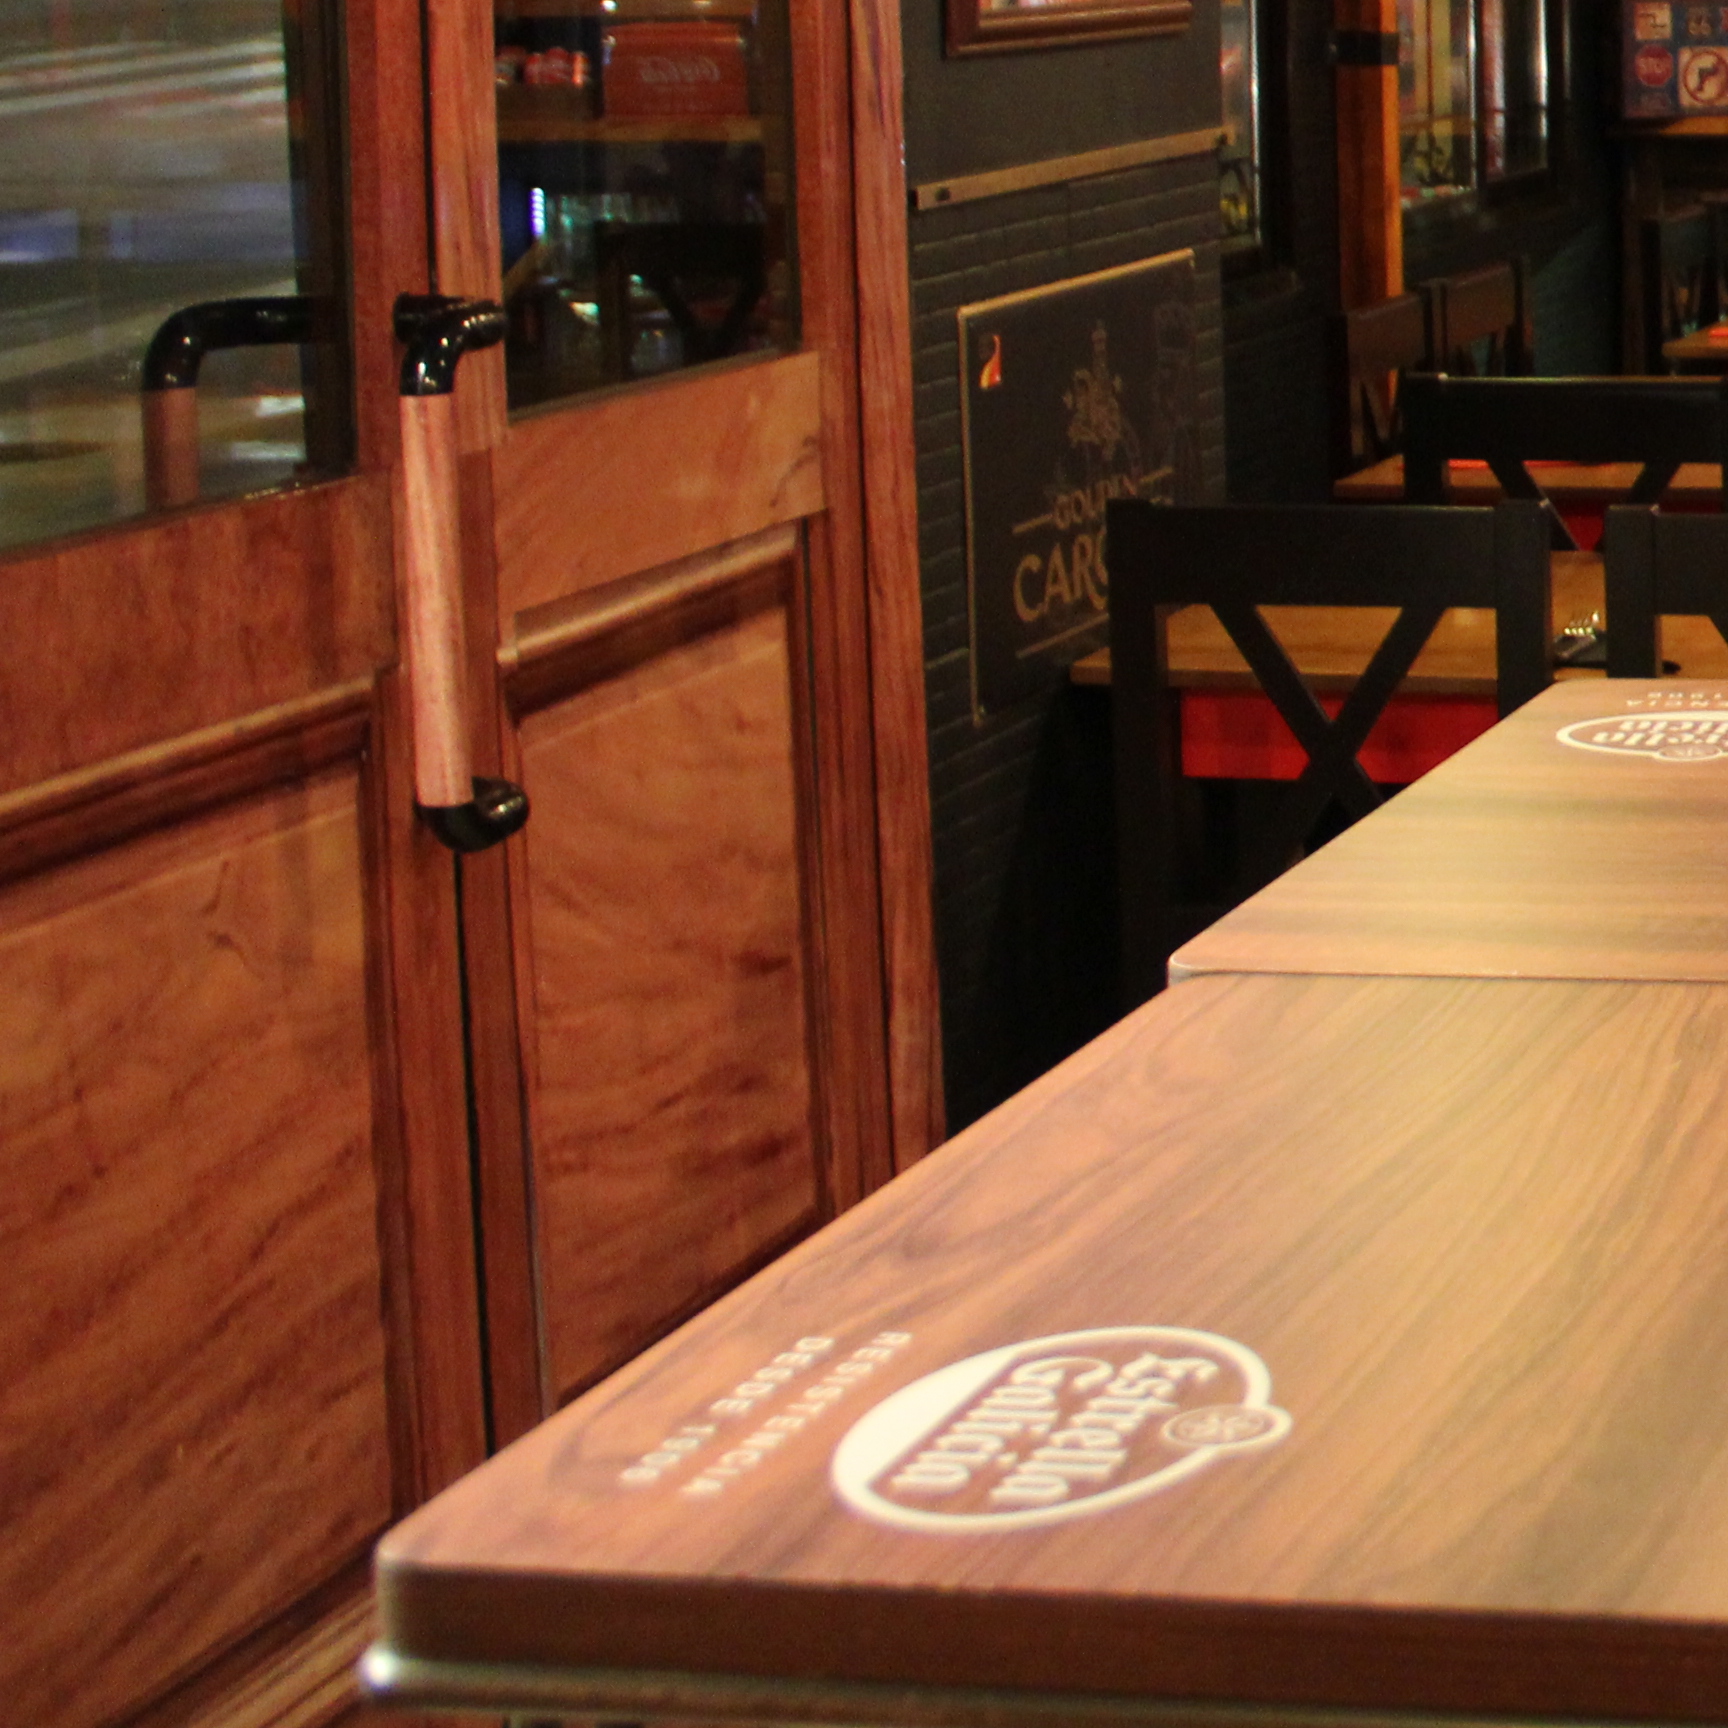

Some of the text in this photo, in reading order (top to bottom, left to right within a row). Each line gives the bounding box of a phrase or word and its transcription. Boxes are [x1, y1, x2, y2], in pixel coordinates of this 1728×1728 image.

[680, 1331, 914, 1500] RESISTENCIA
[711, 1336, 834, 1418] DESDE
[889, 1355, 1113, 1494] Galicia
[991, 1351, 1222, 1504] Estrella
